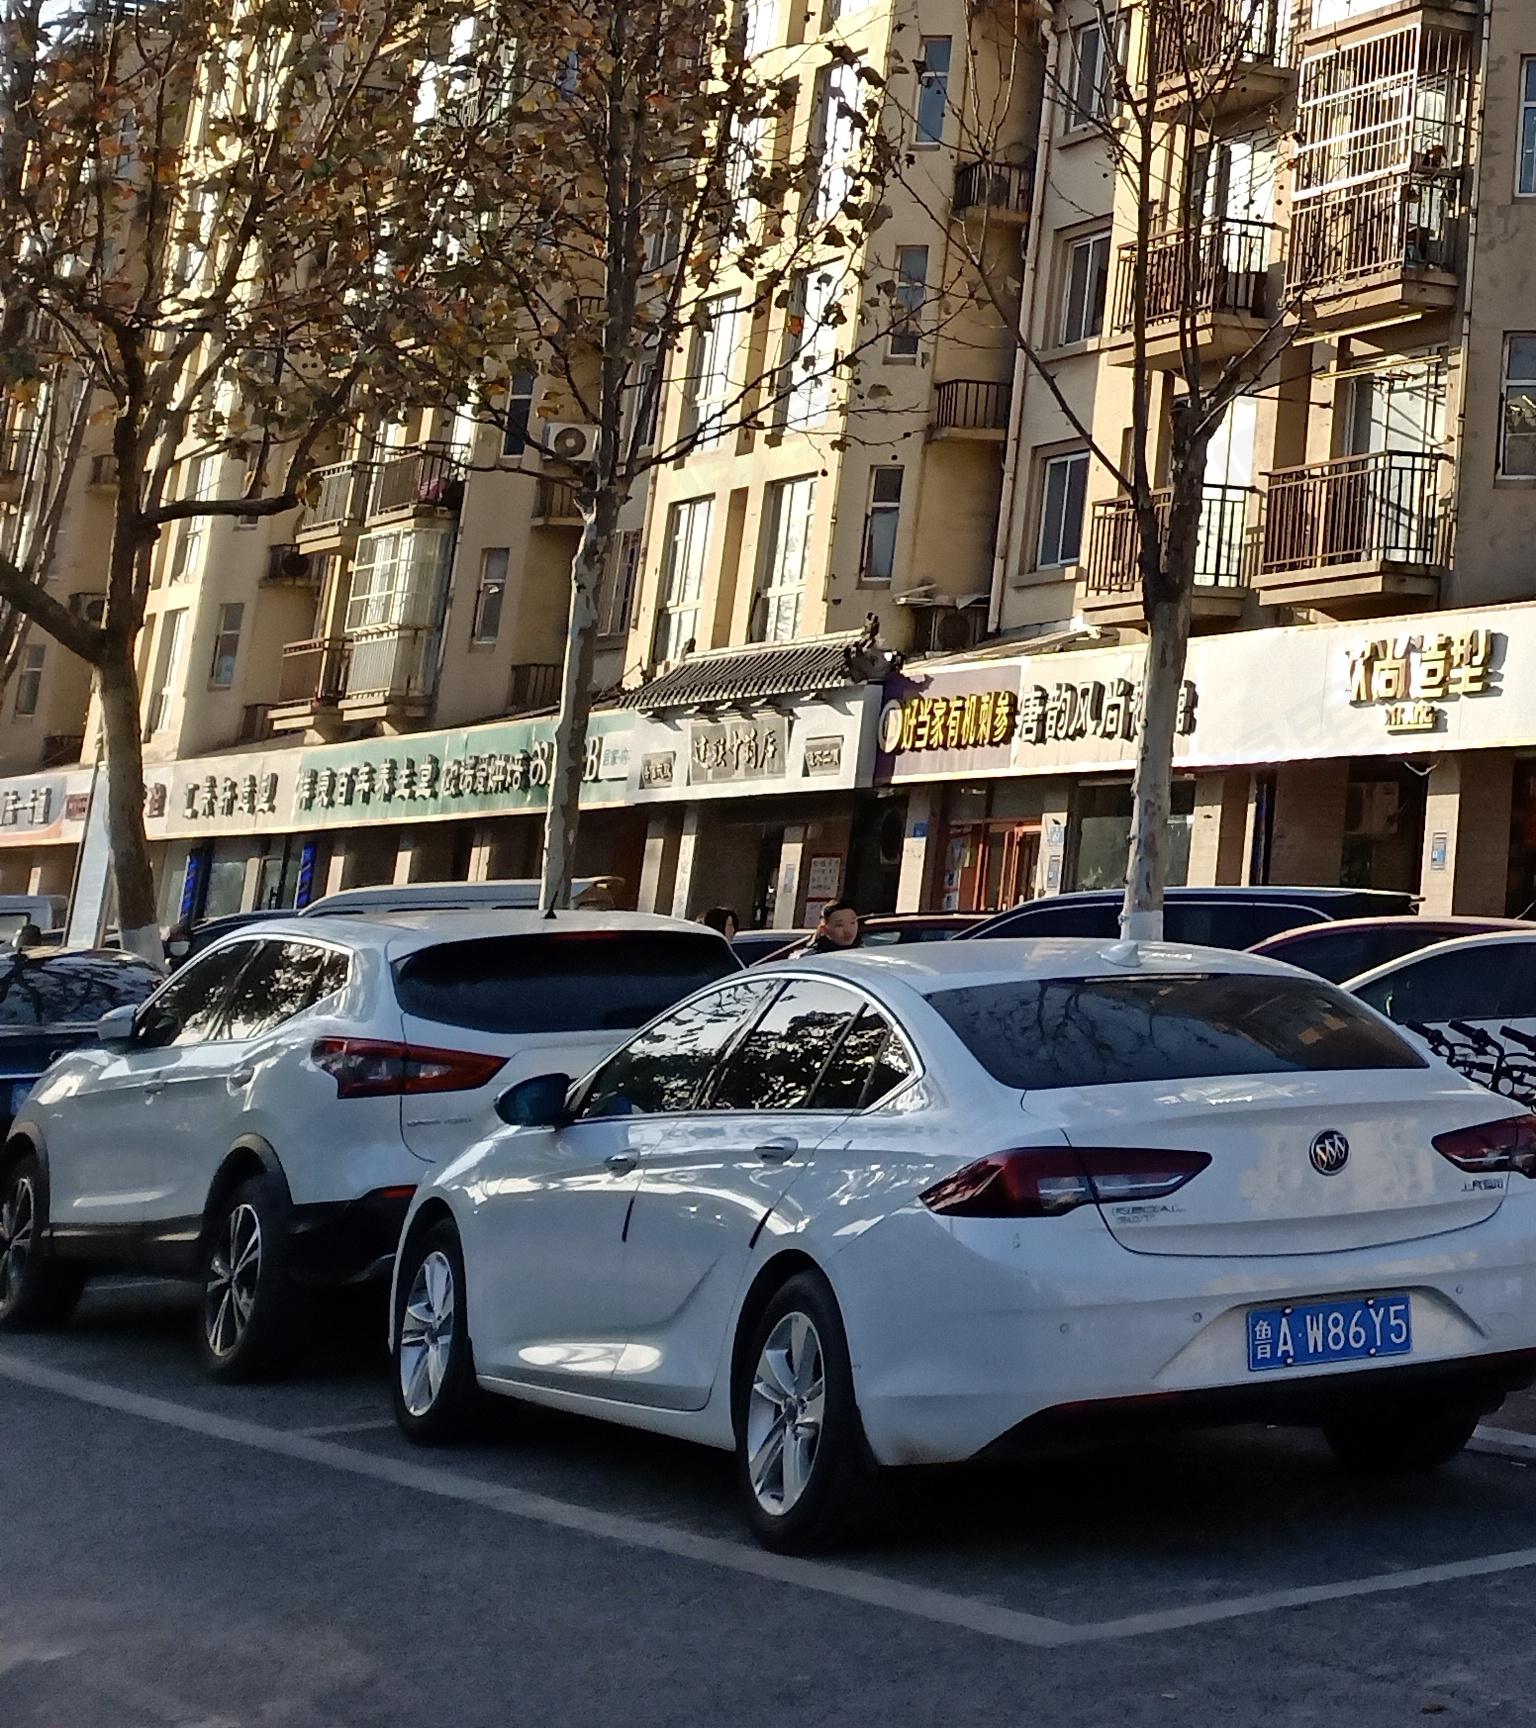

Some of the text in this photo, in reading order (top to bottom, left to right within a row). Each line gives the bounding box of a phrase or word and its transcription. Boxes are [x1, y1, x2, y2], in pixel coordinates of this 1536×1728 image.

[900, 692, 1010, 751] 好当家有机刺参
